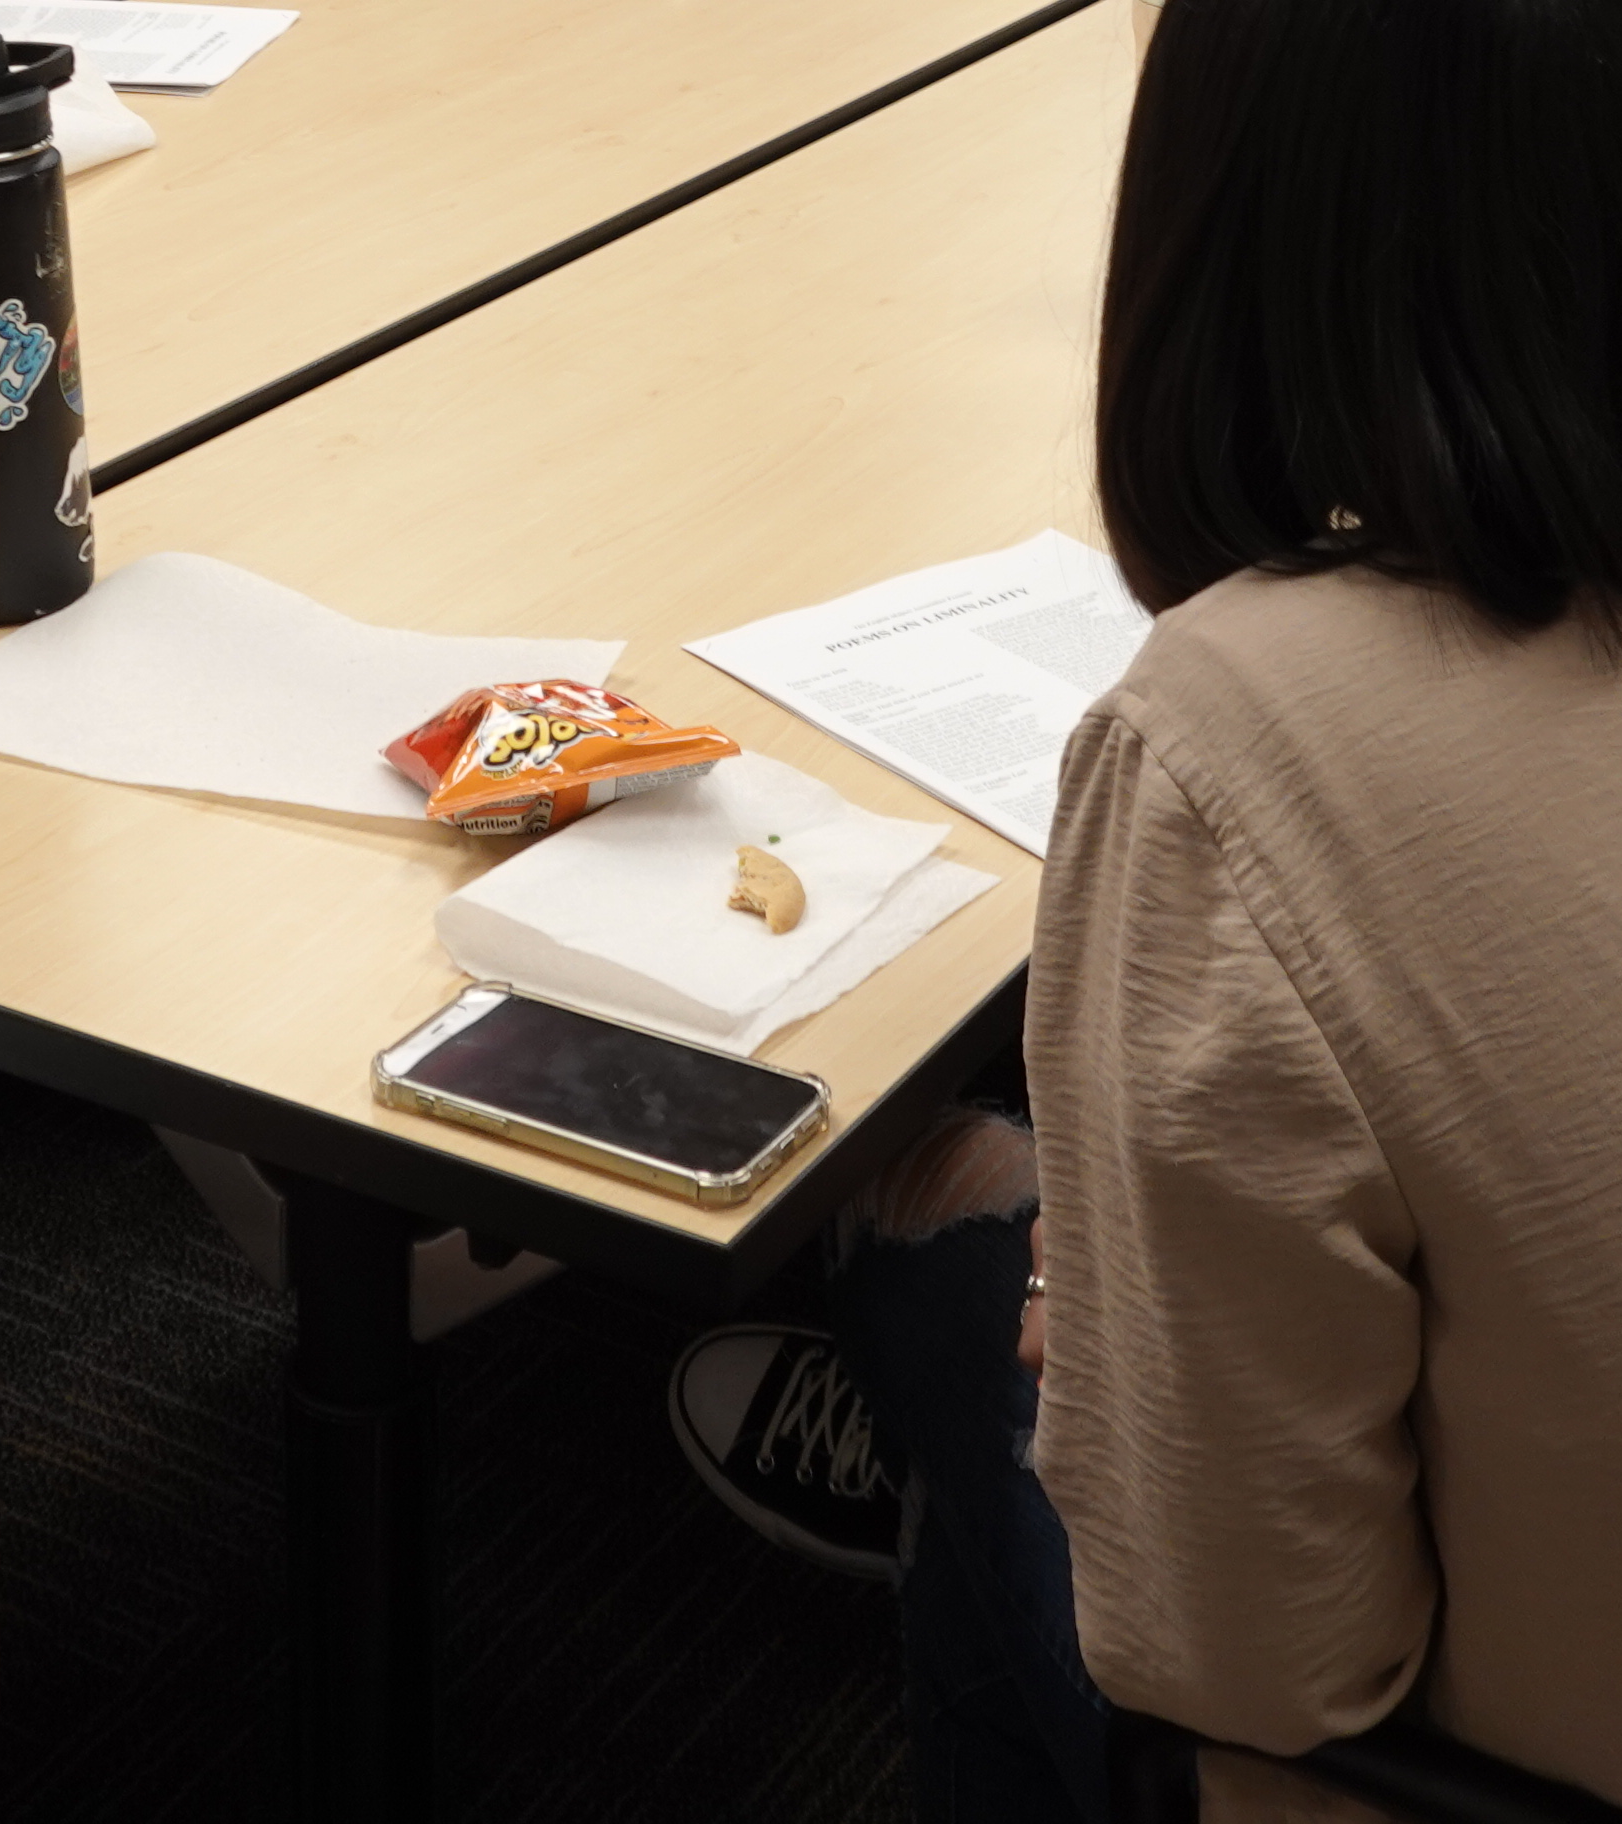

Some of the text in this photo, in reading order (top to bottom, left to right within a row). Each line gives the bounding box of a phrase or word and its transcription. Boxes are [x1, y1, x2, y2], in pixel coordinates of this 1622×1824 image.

[826, 629, 892, 653] POEMS
[892, 619, 923, 634] ON
[922, 587, 1030, 625] LIMINALITY
